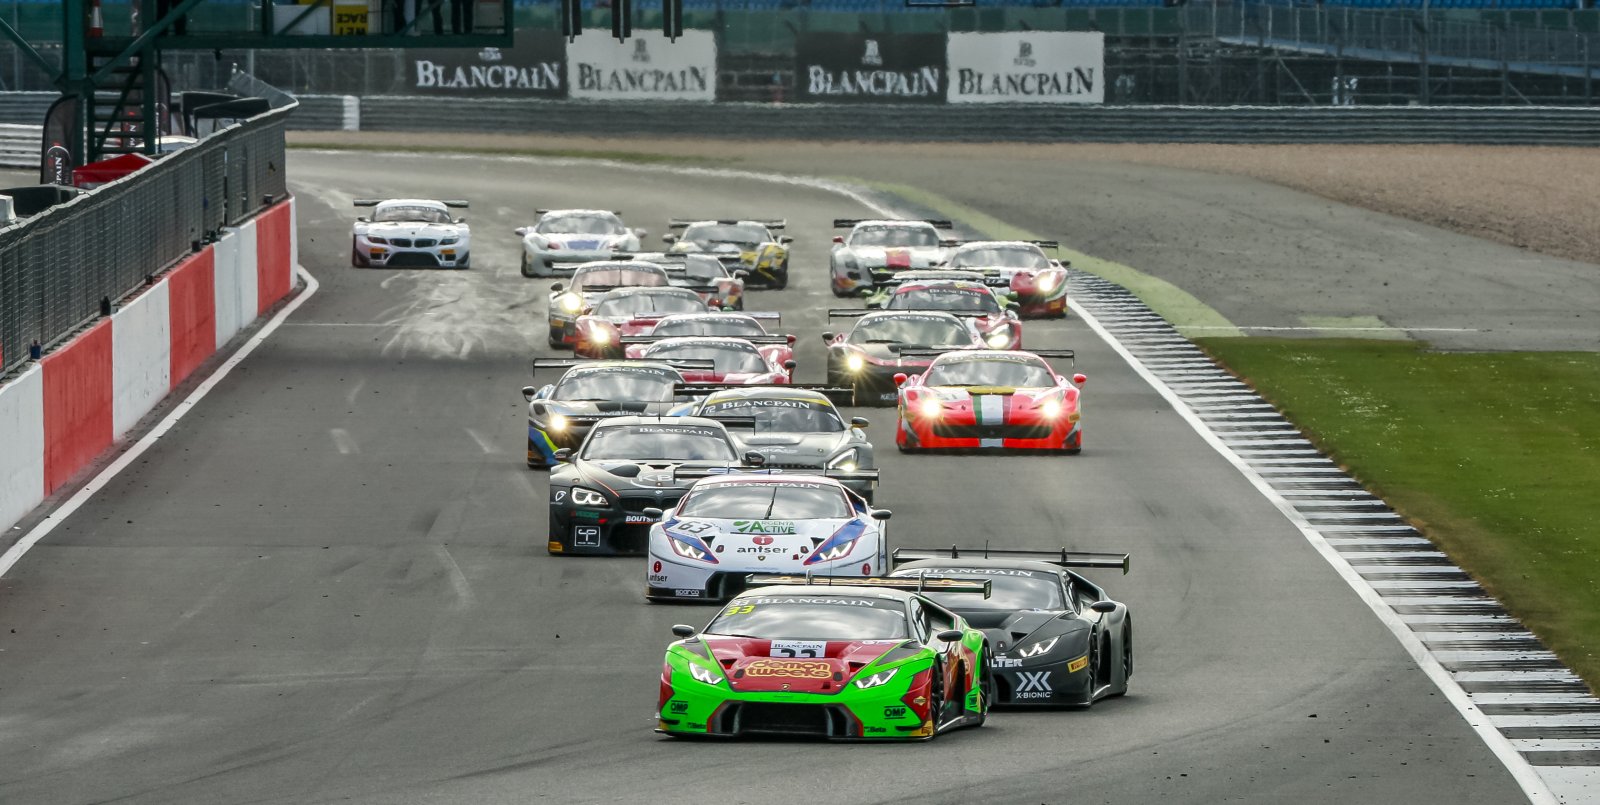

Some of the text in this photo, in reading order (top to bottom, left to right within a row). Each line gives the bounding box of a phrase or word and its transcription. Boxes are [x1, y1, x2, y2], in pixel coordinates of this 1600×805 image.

[416, 60, 561, 90] BLANCPAIN
[578, 62, 709, 92] BLANCPAIN
[808, 65, 940, 95] BLANCPAIN
[958, 66, 1094, 96] BLANCPAIN
[722, 400, 810, 409] BLANCPAIN
[639, 427, 714, 436] BLANCPAIN
[677, 520, 713, 534] 63
[736, 545, 789, 554] antser
[756, 598, 876, 607] BLANCPAIN
[725, 605, 755, 616] 33
[750, 660, 830, 670] demon
[746, 667, 831, 678] tweeks
[1016, 691, 1051, 699] X-BIONIC
[671, 702, 688, 711] OMP
[884, 707, 906, 717] OMP
